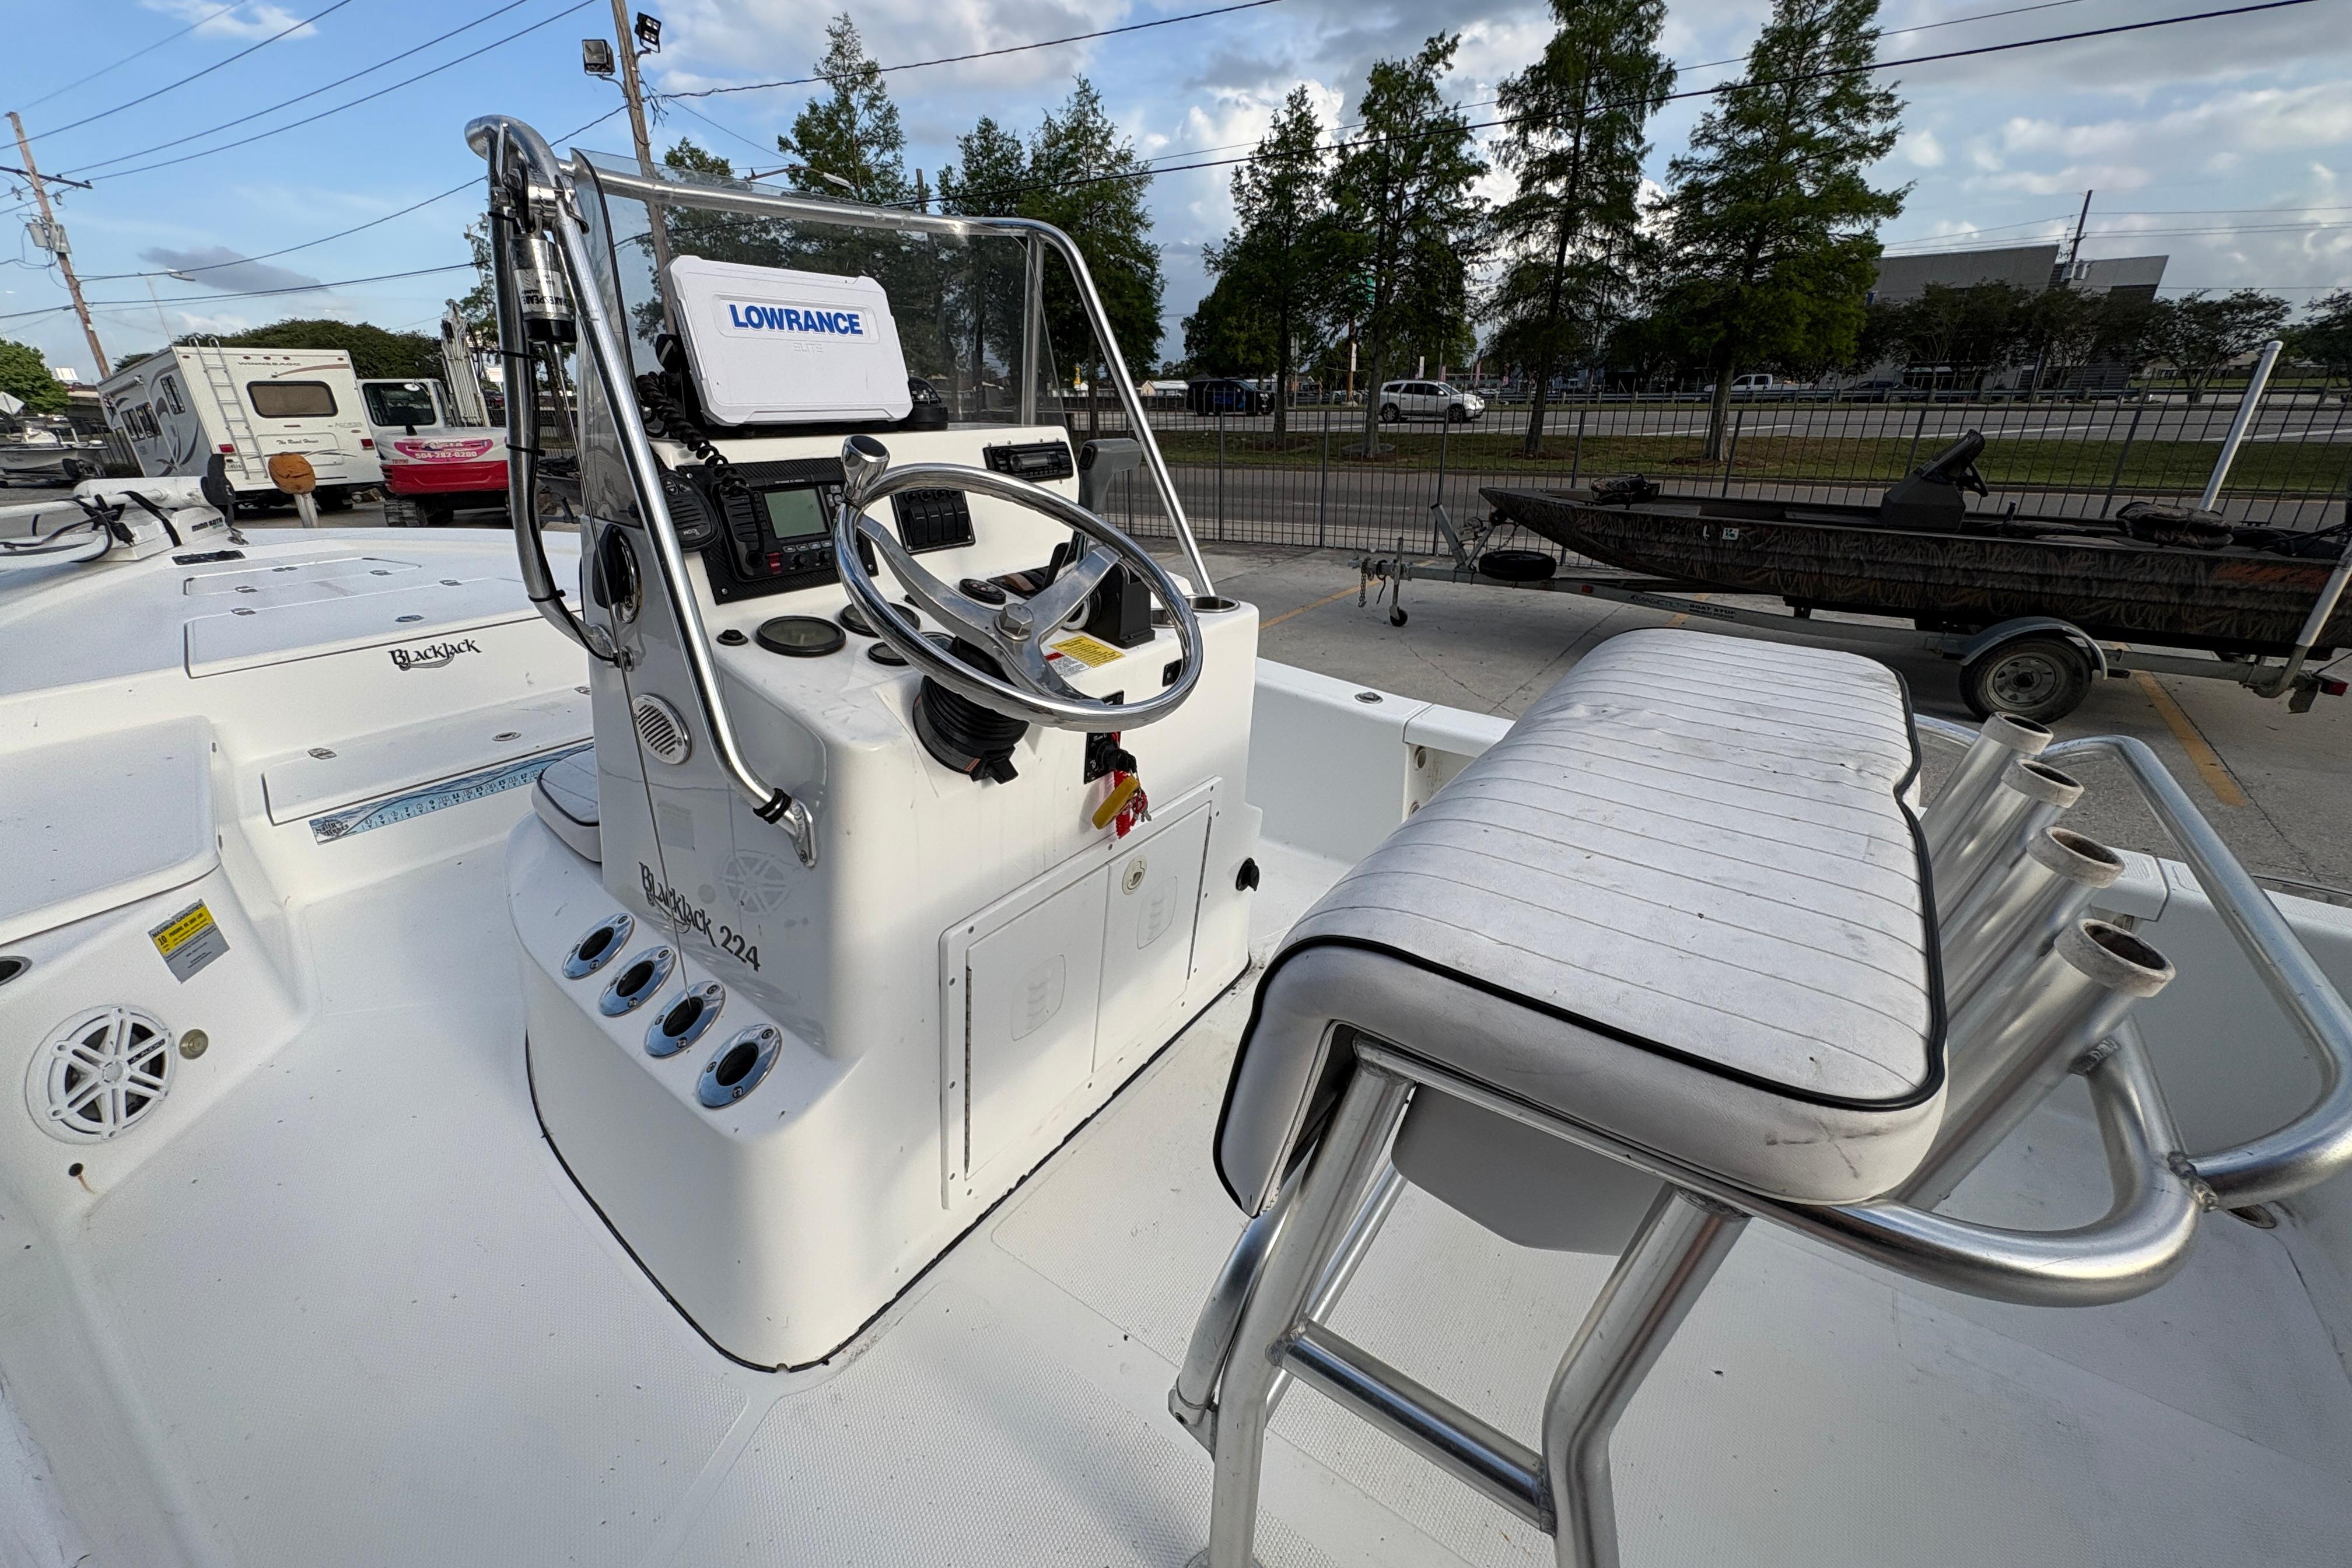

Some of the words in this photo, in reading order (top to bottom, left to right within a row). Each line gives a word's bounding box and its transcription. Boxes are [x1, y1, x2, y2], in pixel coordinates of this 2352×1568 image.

[729, 304, 863, 335] LOWRANCE
[794, 342, 824, 353] ELITE
[415, 451, 477, 459] 504-282-0200
[158, 935, 167, 946] 10
[720, 925, 761, 972] 224
[141, 1041, 163, 1056] AUDIO
